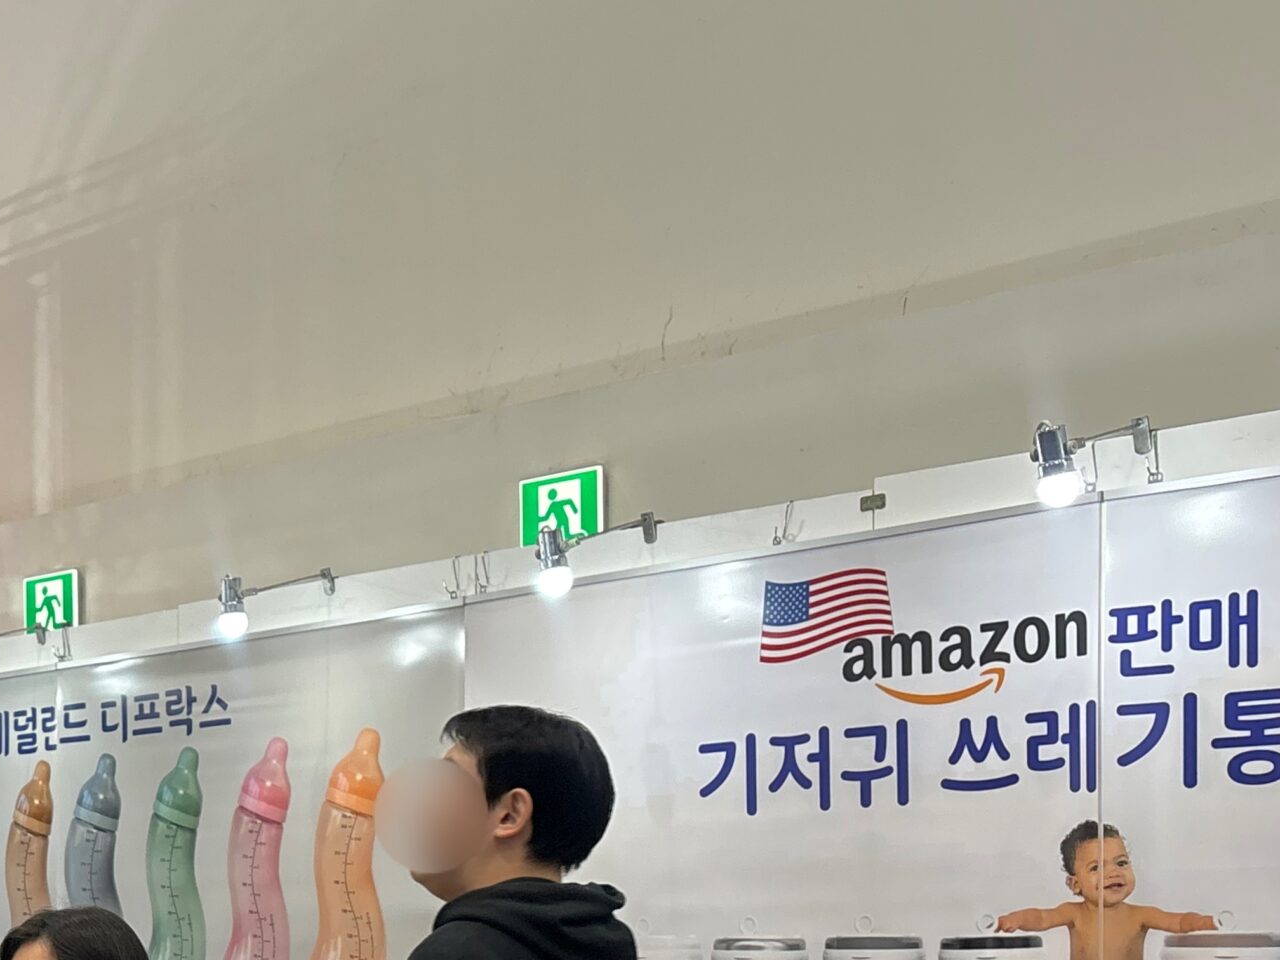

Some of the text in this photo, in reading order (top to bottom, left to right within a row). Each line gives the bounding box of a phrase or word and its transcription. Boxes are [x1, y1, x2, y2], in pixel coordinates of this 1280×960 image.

[842, 588, 1260, 683] amazon 판매
[101, 683, 231, 744] 디프락스
[698, 718, 910, 816] 기저귀
